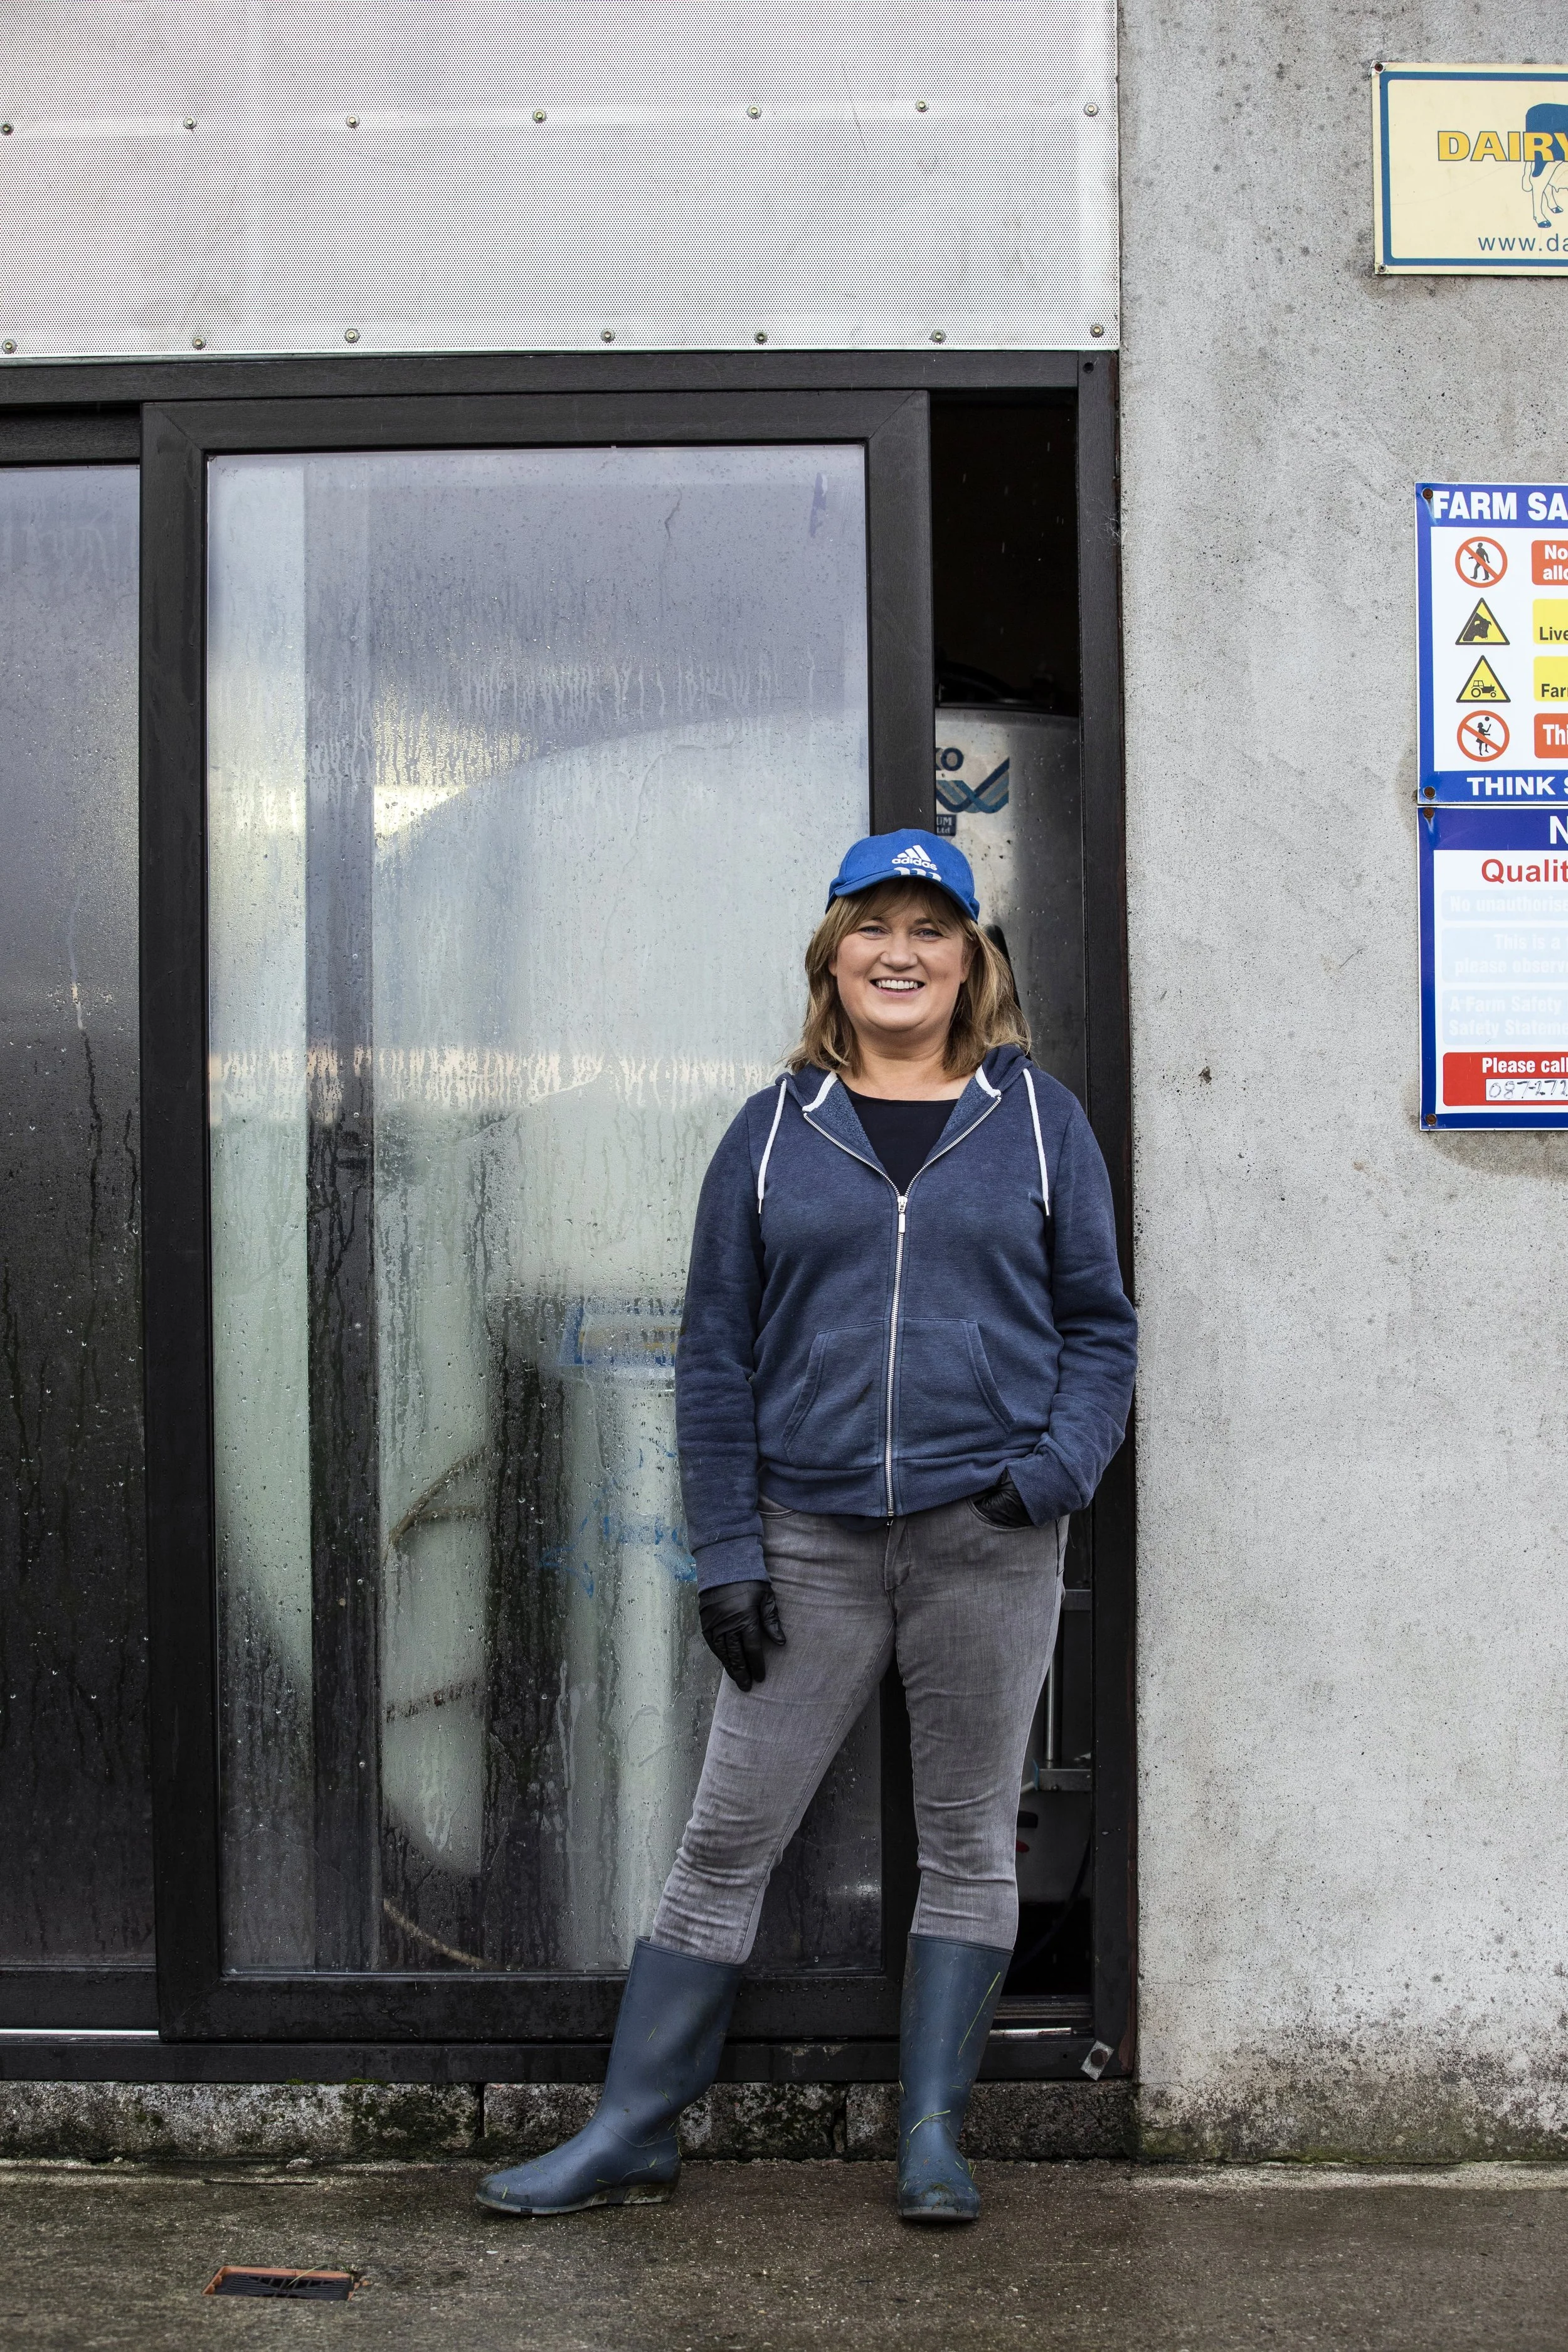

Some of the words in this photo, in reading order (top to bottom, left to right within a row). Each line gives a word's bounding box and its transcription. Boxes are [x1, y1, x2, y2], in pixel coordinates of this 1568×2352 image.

[1433, 490, 1517, 520] FARM
[1528, 492, 1568, 521] SA
[1545, 544, 1568, 560] No
[1540, 627, 1568, 640] Live
[1541, 683, 1568, 697] Far
[1467, 776, 1555, 796] THINK
[1550, 815, 1568, 844] N
[891, 856, 938, 871] adidas
[1481, 859, 1568, 884] Qualit
[1450, 896, 1470, 912] No
[1494, 933, 1527, 950] This
[1532, 934, 1545, 950] is
[1550, 937, 1561, 950] a
[1454, 957, 1507, 976] please
[1513, 958, 1568, 973] observ
[1450, 996, 1460, 1012] A
[1468, 996, 1505, 1012] Farm
[1511, 996, 1562, 1015] Safety
[1449, 1019, 1499, 1039] Safety
[1482, 1057, 1535, 1073] Please
[1541, 1057, 1568, 1073] call
